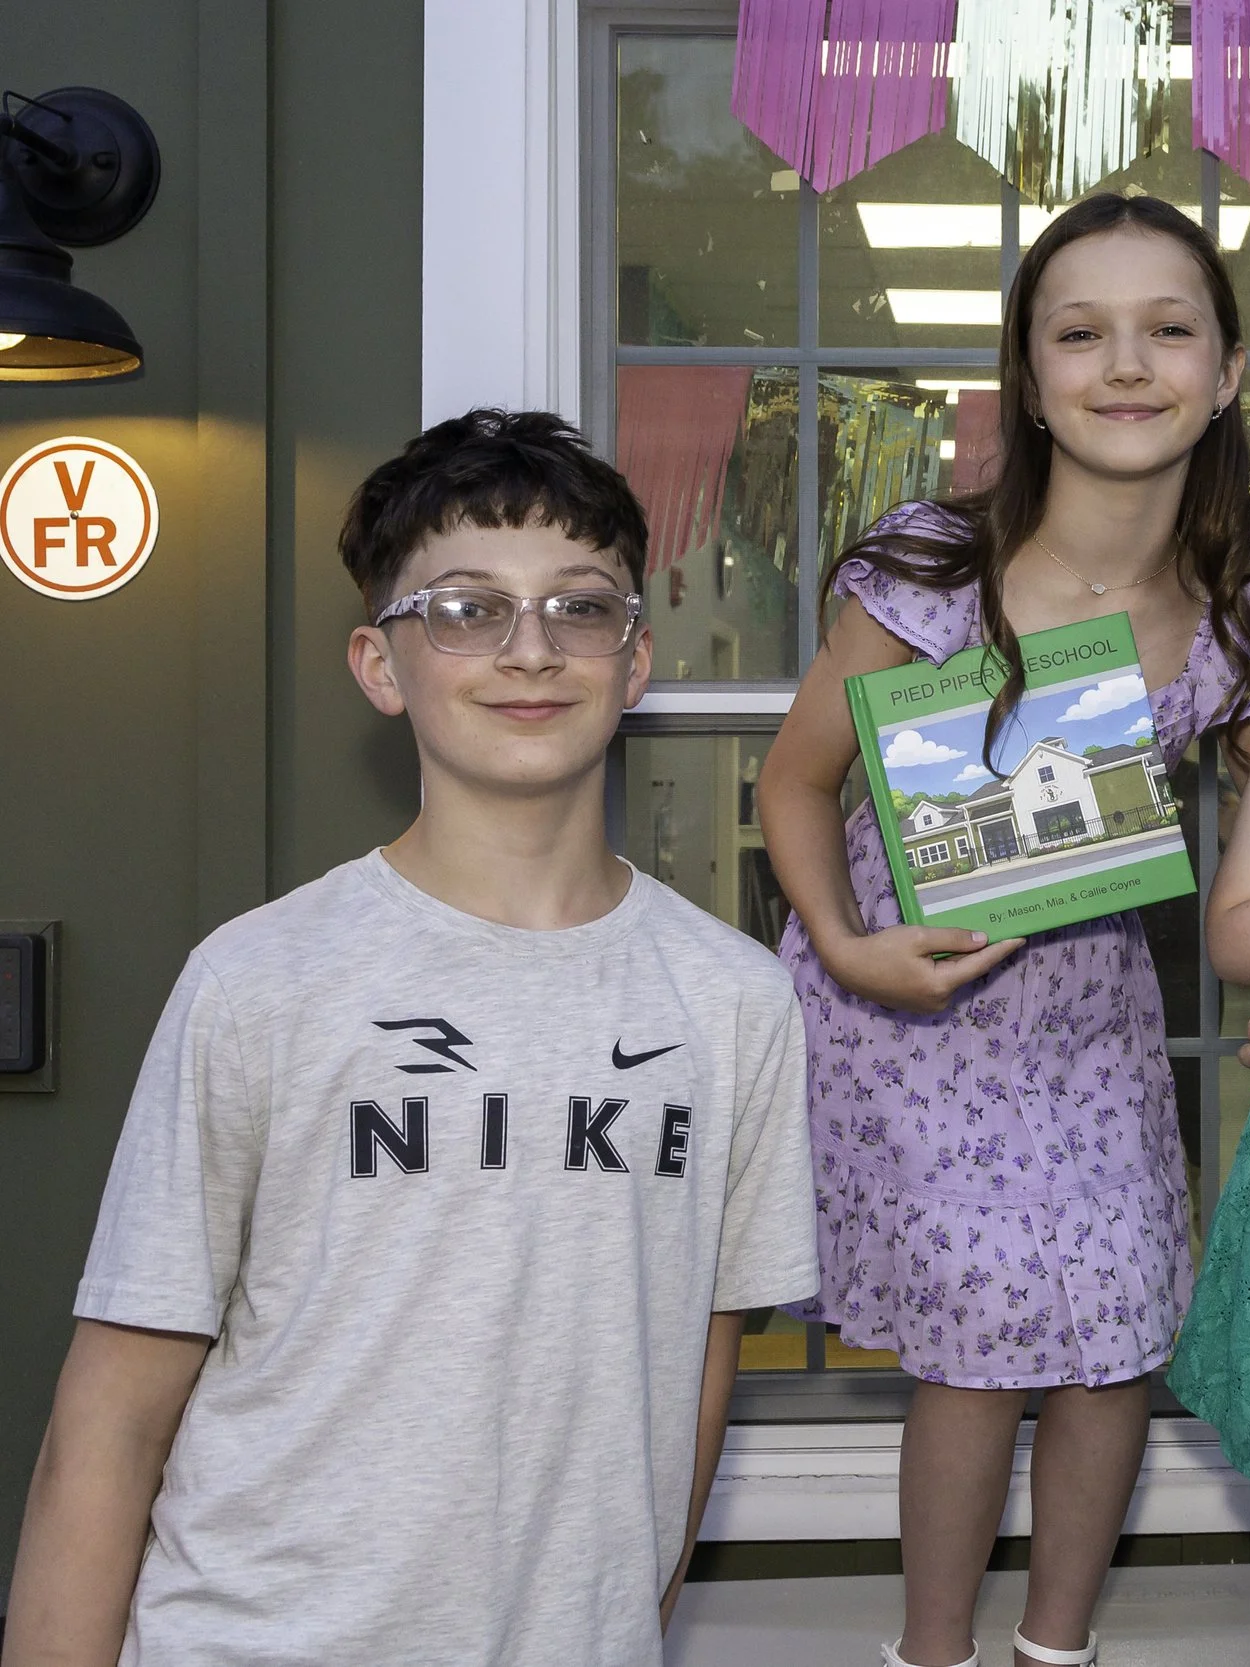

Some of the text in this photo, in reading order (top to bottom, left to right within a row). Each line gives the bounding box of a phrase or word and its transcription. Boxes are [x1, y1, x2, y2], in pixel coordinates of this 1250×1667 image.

[53, 460, 96, 511] V
[33, 516, 117, 568] FR
[890, 639, 1119, 706] PIED PIPER PESCHOOL
[989, 912, 1006, 924] By:
[1007, 901, 1045, 919] Mason,
[1070, 892, 1078, 903] &
[1080, 885, 1108, 900] Callie
[1110, 877, 1142, 893] Coyne
[350, 1093, 692, 1178] NIKE
